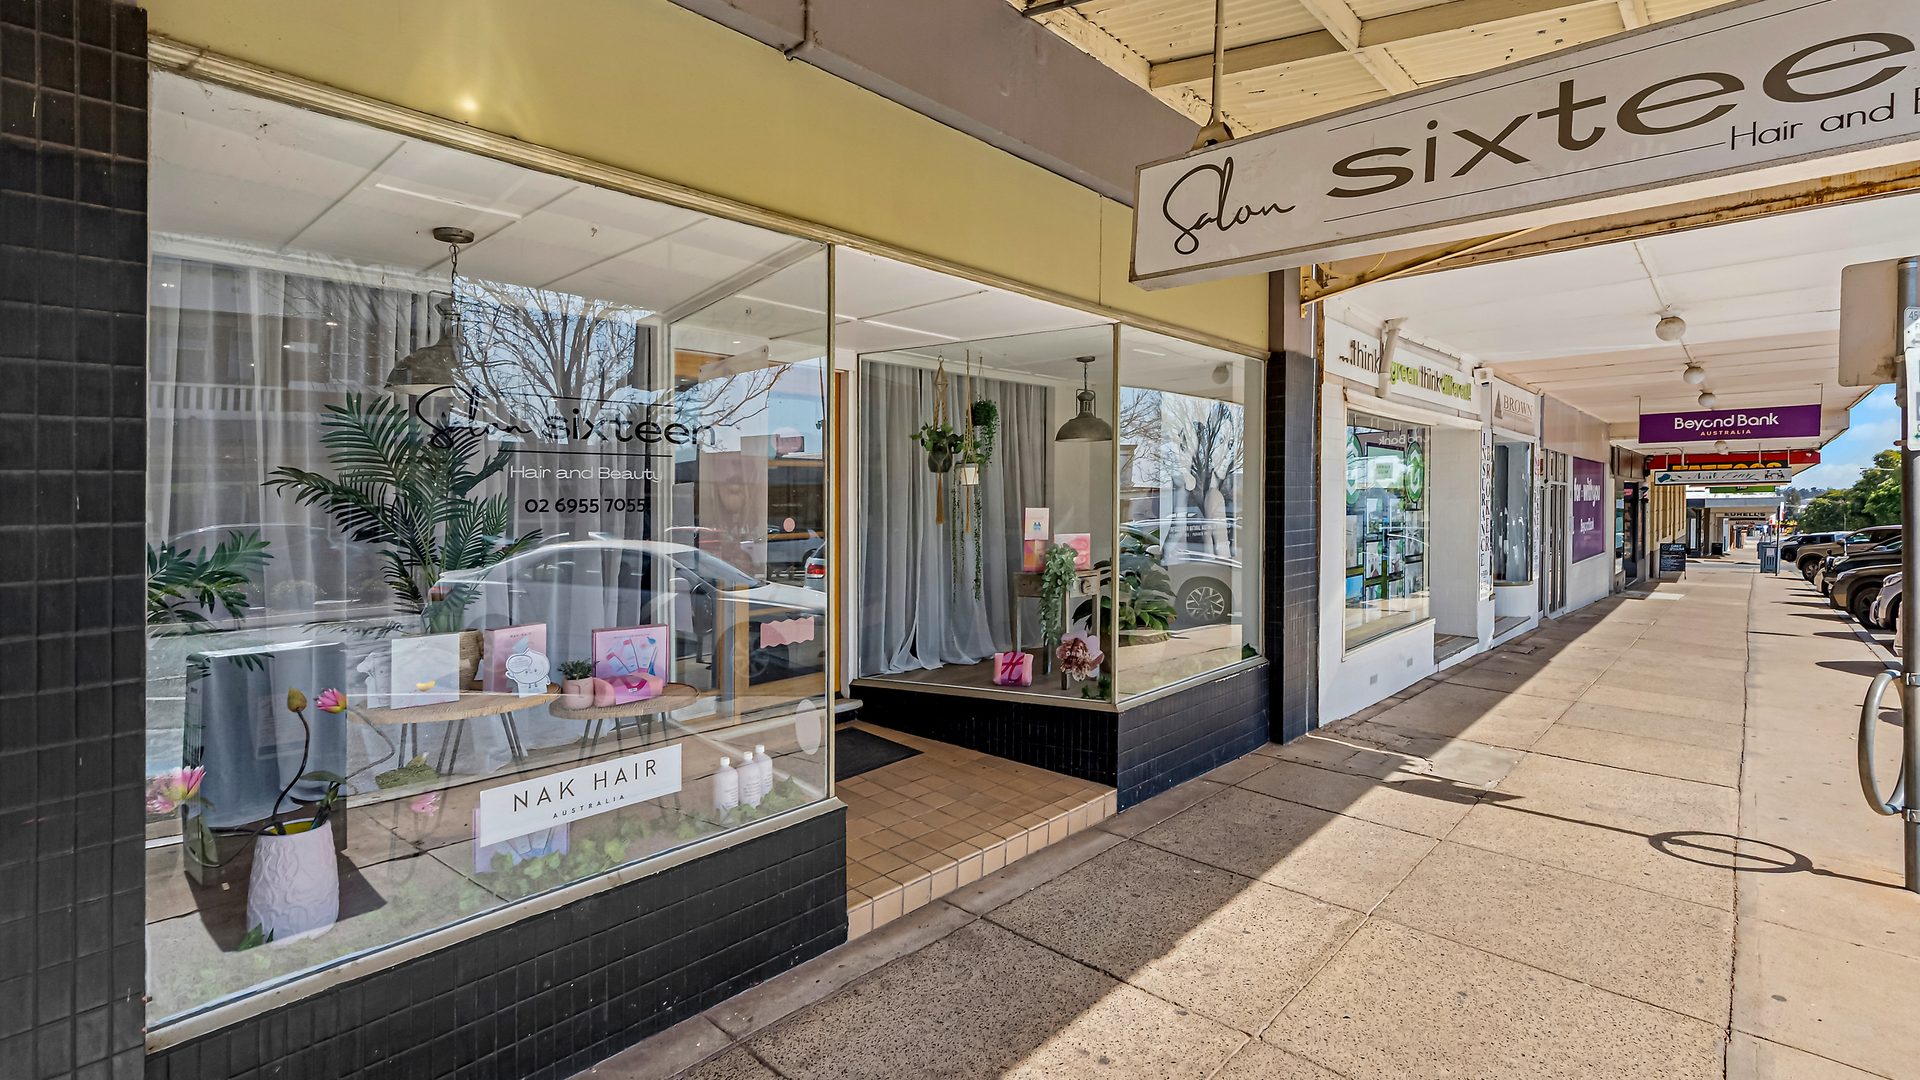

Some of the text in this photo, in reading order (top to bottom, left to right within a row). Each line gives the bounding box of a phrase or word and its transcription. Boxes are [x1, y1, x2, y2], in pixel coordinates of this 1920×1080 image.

[1731, 120, 1803, 150] Hair
[1820, 92, 1895, 132] and
[1162, 156, 1296, 255] Salon
[543, 407, 716, 446] sixteen
[1674, 412, 1779, 431] Beyond Bank
[510, 465, 663, 483] Hair and Beauty
[524, 498, 646, 514] 02 6955 7055
[513, 759, 657, 812] NAK HAIR
[552, 794, 625, 819] AUSTRALIA
